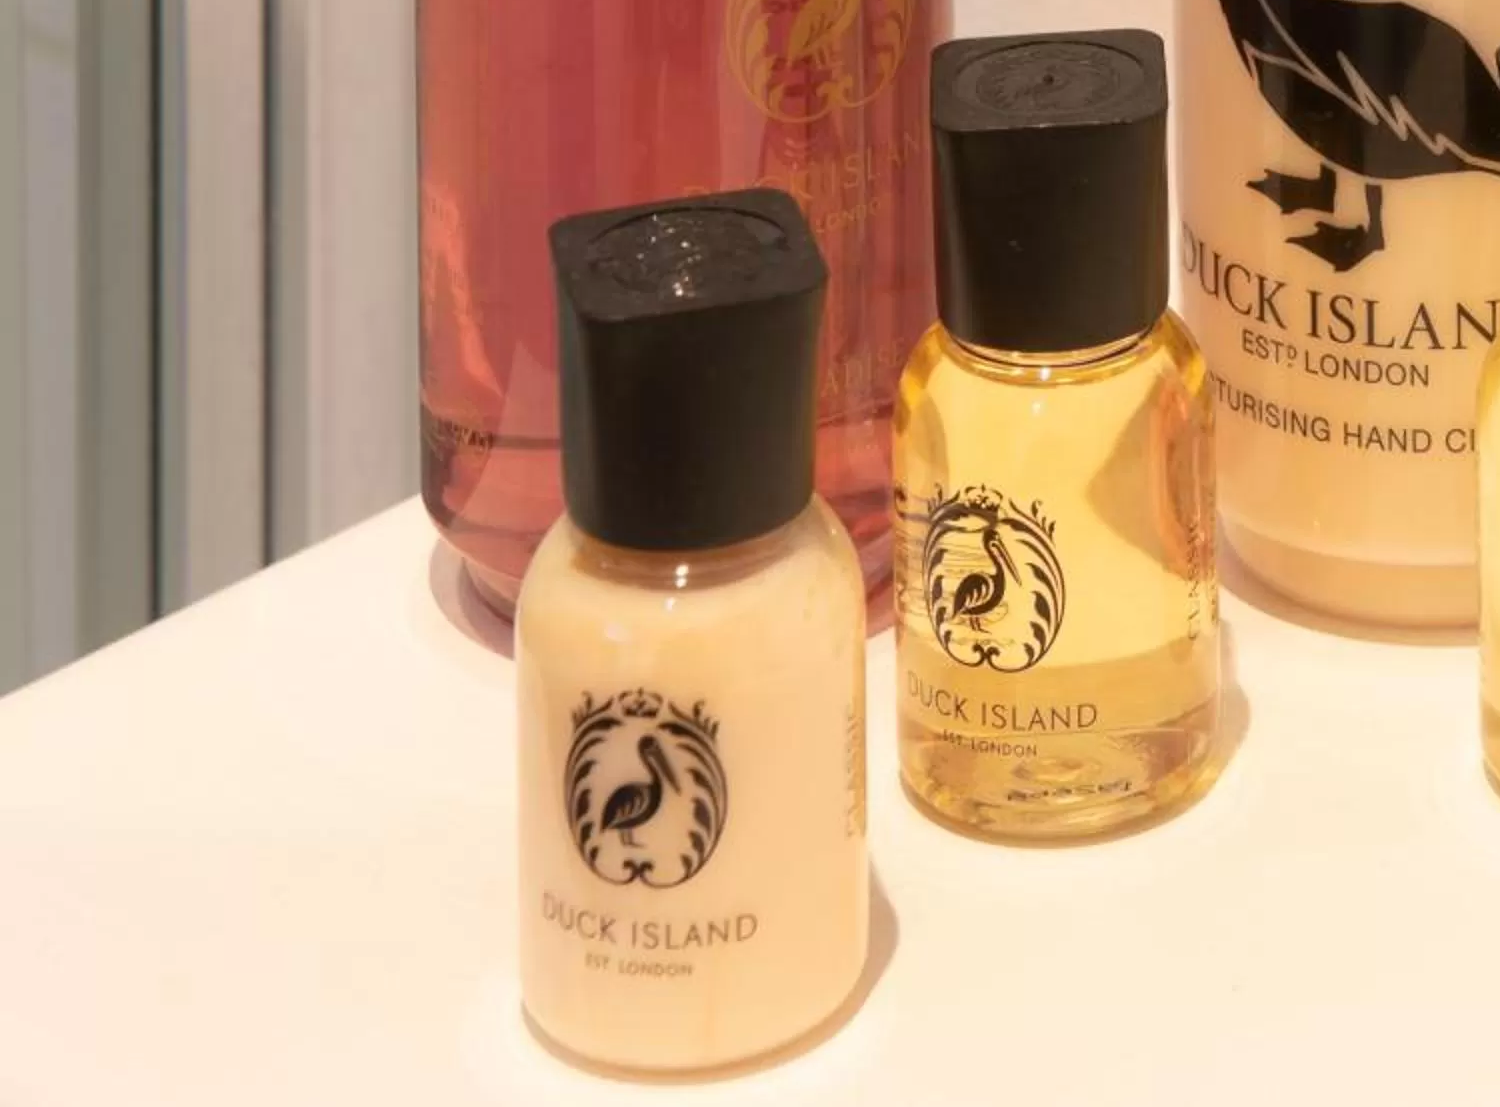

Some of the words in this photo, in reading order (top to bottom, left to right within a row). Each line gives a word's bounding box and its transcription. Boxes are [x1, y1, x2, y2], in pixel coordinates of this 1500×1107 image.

[1305, 348, 1430, 388] LONDON
[1208, 369, 1332, 443] TURISING
[1343, 421, 1432, 455] HAND
[907, 671, 970, 723] DUCK
[981, 702, 1098, 732] ISLAND
[971, 737, 1037, 758] LONDON
[542, 890, 617, 944] DUCK
[631, 913, 759, 950] ISLAND
[618, 958, 693, 976] LONDON
